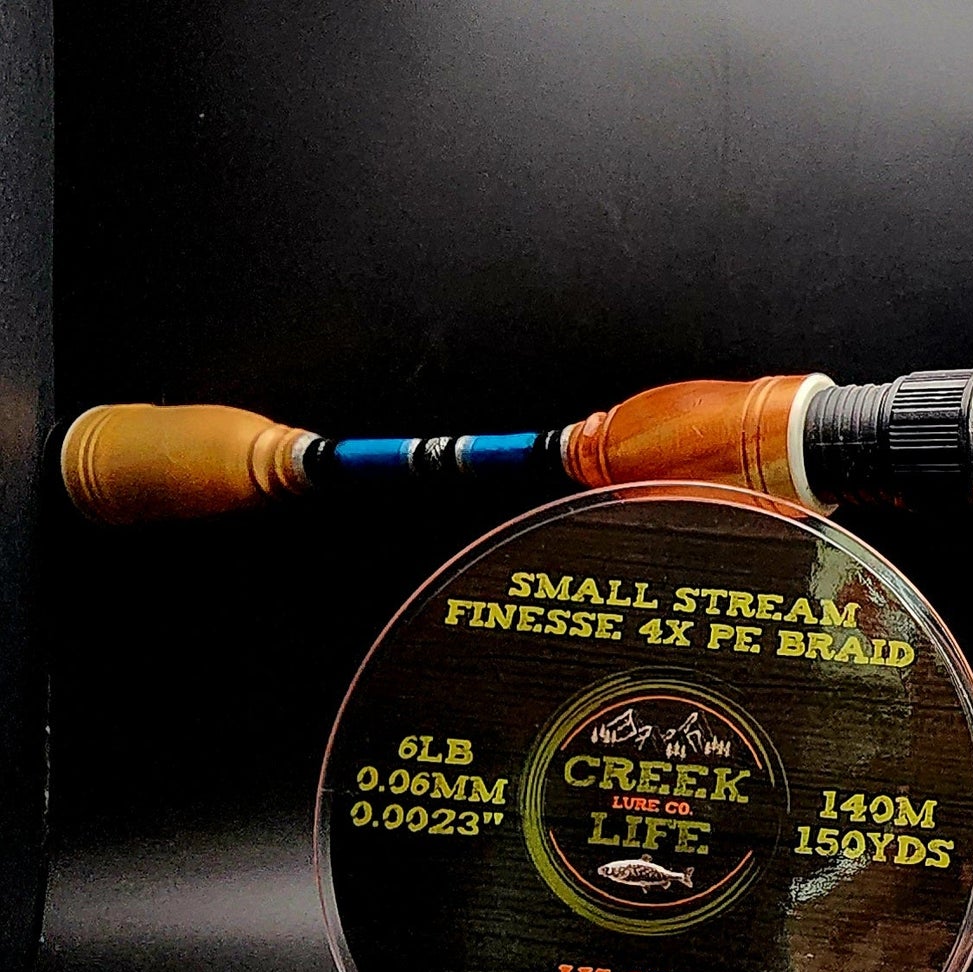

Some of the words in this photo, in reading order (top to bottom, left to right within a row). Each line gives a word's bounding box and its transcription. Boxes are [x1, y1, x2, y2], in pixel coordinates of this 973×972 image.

[508, 572, 659, 609] SMALL
[673, 586, 859, 627] STREAM
[444, 600, 623, 639] FINESSE
[638, 617, 693, 647] 4X
[706, 623, 761, 654] PE
[776, 632, 915, 667] BRAID
[397, 735, 473, 764] 6LB
[356, 766, 506, 805] 0.06MM
[563, 754, 751, 803] CREEK
[611, 795, 661, 814] LURE
[664, 801, 693, 816] CO.
[819, 790, 937, 828] 140M
[587, 813, 710, 855] LIFE
[794, 826, 954, 868] 150YDS
